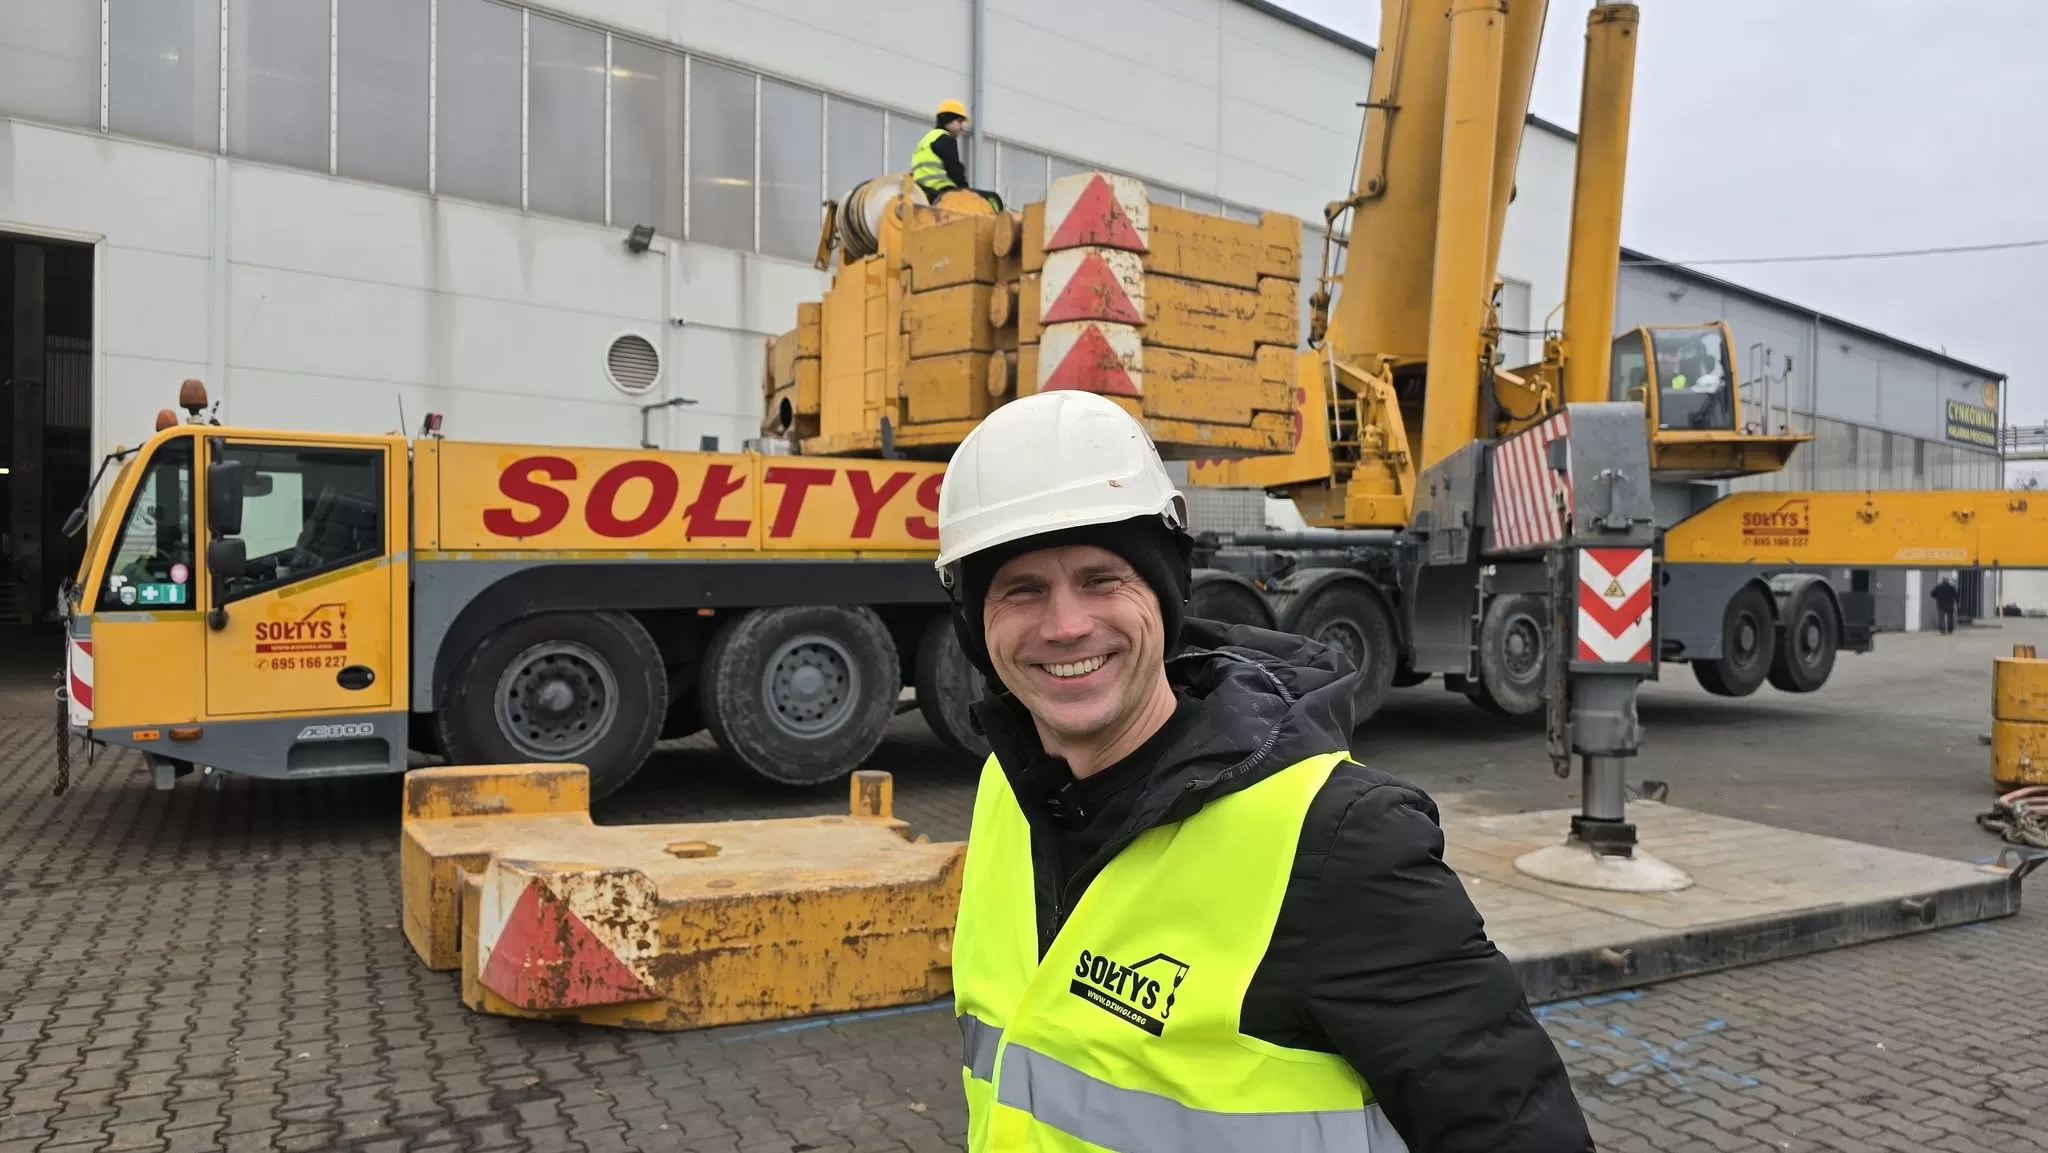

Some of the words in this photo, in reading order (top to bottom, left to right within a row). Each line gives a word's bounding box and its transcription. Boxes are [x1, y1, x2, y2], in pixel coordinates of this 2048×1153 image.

[1949, 400, 1995, 430] CYNKOWNIA
[1743, 512, 1798, 527] SOŁTYS
[256, 620, 332, 640] SOŁTYS
[271, 657, 296, 670] 695
[299, 656, 322, 669] 166
[324, 655, 347, 668] 227
[1075, 949, 1161, 1010] SOŁTYS
[1087, 989, 1147, 1026] WWW.DZWIGI.ORG
